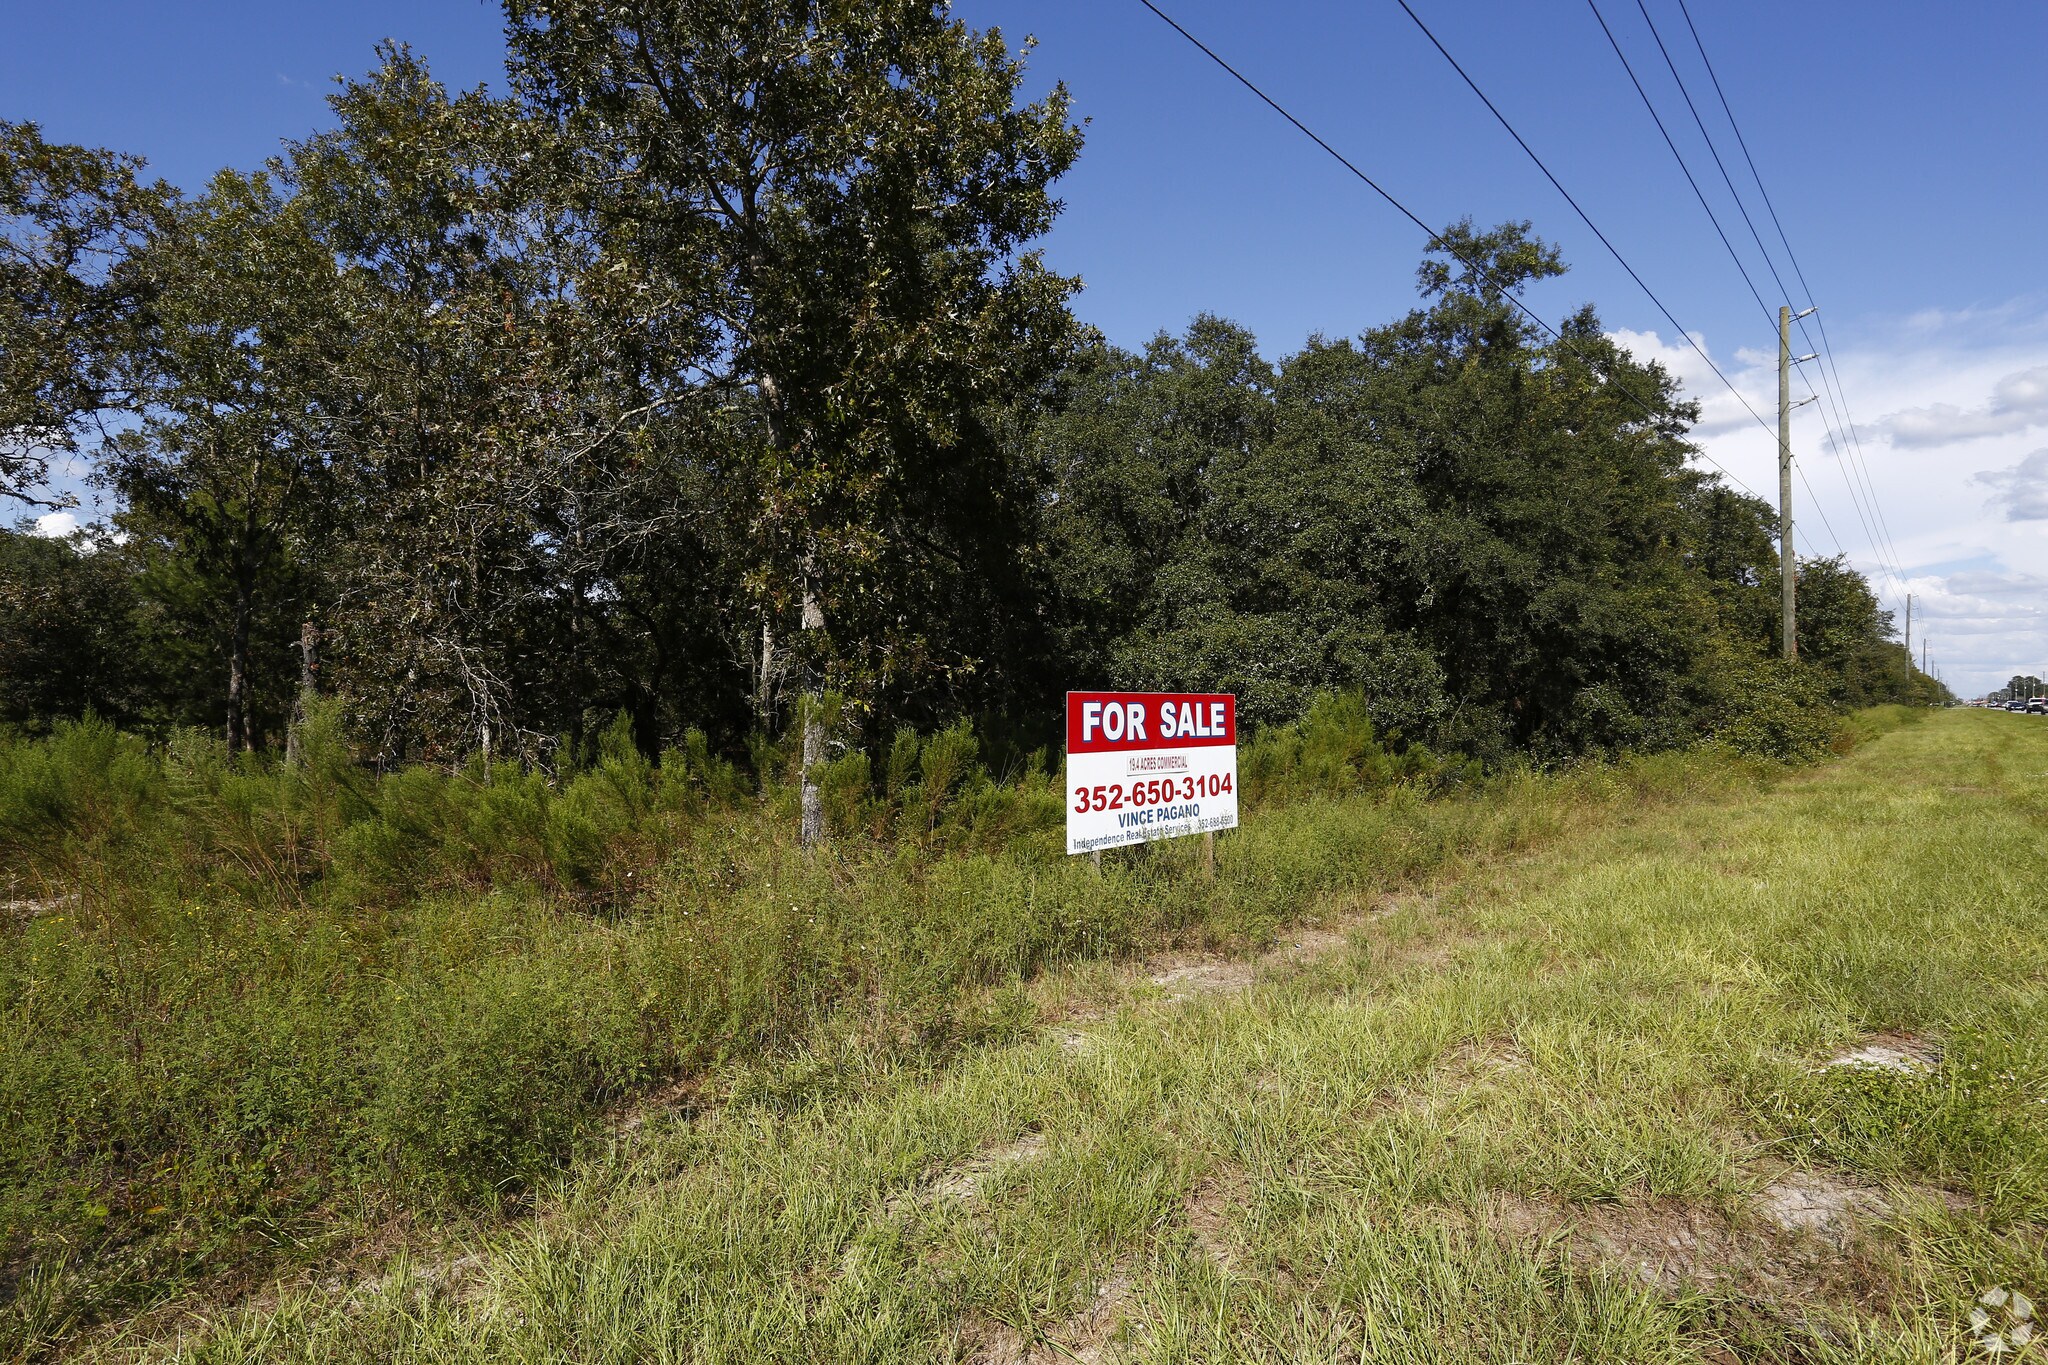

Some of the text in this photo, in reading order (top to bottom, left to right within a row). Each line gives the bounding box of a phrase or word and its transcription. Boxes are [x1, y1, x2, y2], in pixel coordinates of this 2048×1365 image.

[1082, 701, 1226, 742] FOR SALE
[1140, 757, 1156, 770] ACRES
[1157, 756, 1187, 769] COMMERCIAL
[1074, 772, 1232, 814] 352-650-3104
[1118, 803, 1200, 828] VINCE PAGANO
[1073, 833, 1124, 850] Independence
[1126, 829, 1141, 841] Real
